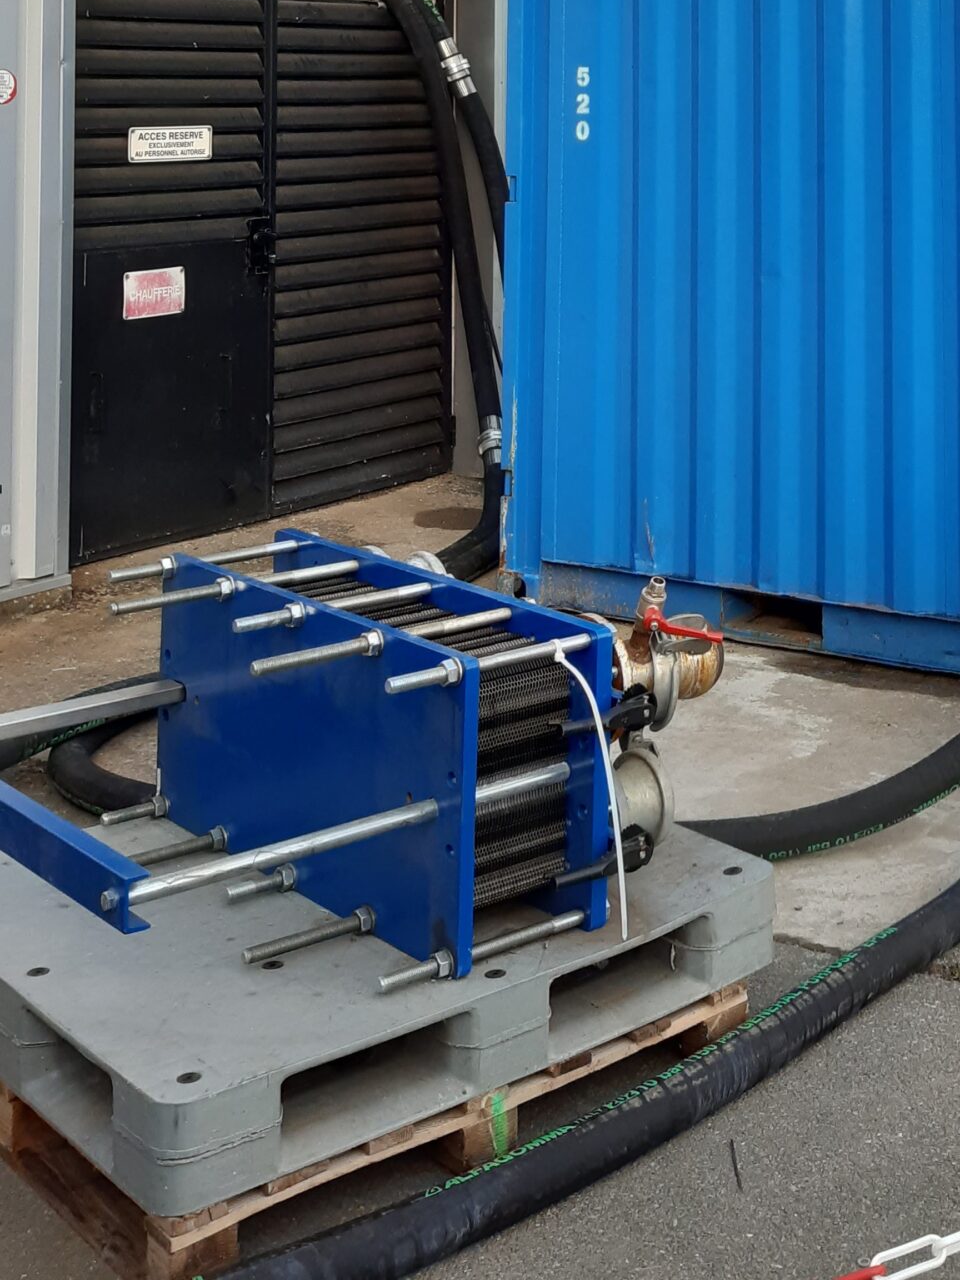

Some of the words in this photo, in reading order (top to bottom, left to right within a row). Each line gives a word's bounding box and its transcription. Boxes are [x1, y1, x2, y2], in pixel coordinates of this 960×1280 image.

[576, 66, 590, 141] 520
[137, 131, 167, 141] ACCES
[168, 130, 204, 140] RESERVE
[148, 141, 194, 149] EXCLUSIVEMENT
[134, 150, 143, 158] AU
[144, 149, 179, 158] PERSONNEL
[180, 148, 206, 156] AUTORISE
[129, 284, 181, 302] CHAUFFERIE
